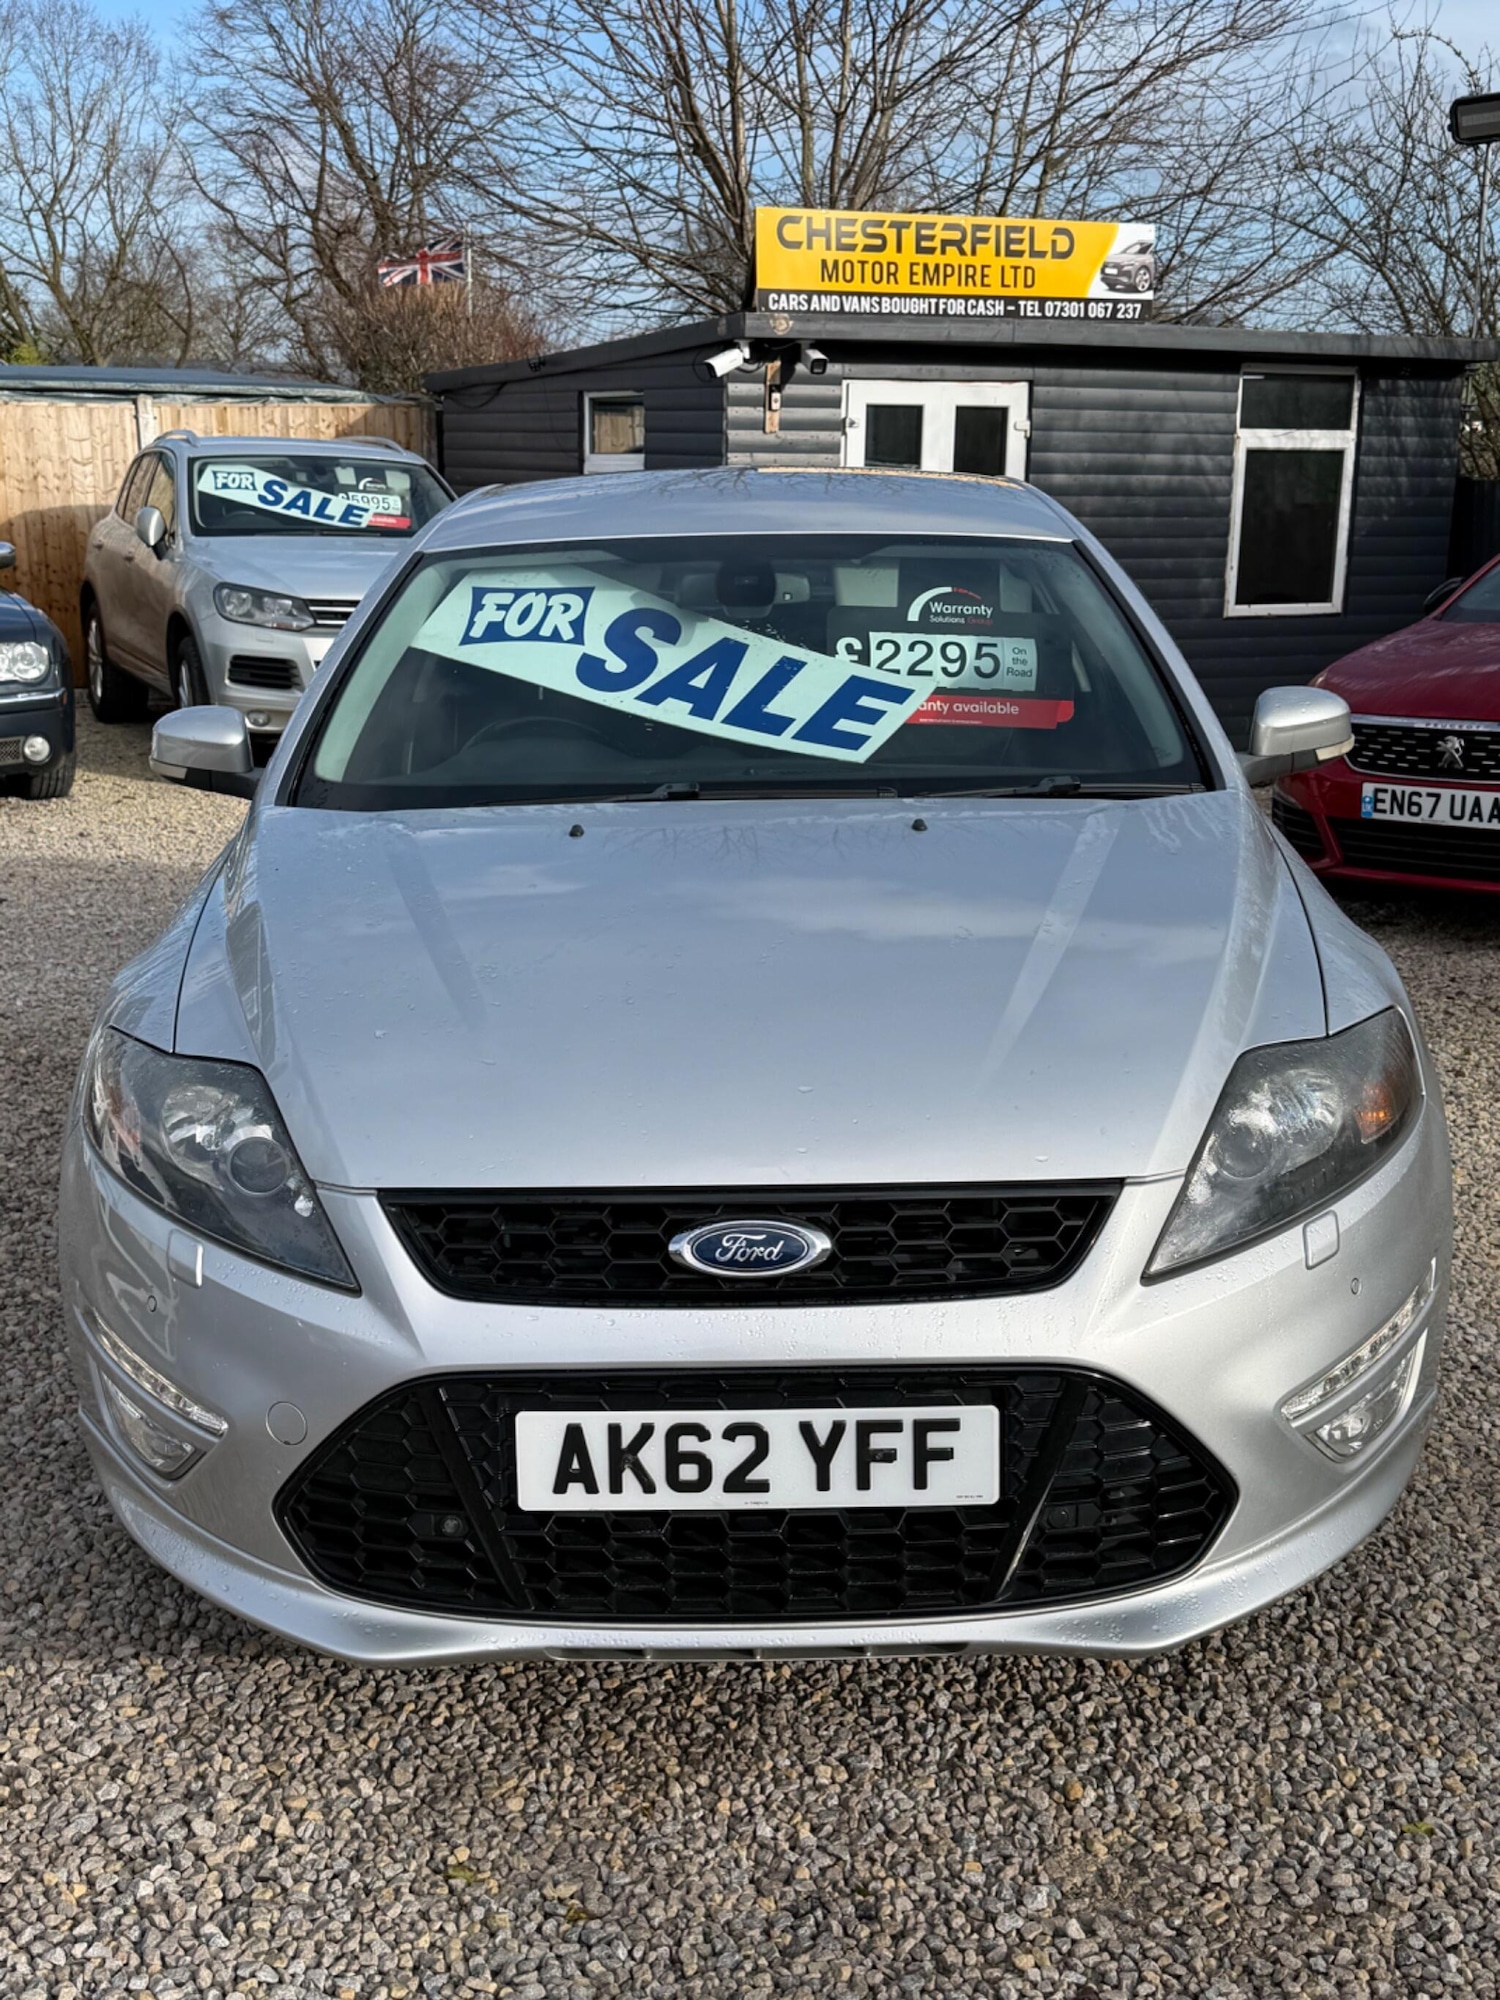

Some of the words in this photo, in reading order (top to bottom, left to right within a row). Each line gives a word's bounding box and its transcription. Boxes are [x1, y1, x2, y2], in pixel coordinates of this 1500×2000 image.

[776, 214, 1075, 259] CHESTERFIELD
[820, 259, 899, 286] MOTOR
[908, 261, 991, 288] EMPIRE
[1000, 264, 1036, 289] LTD
[768, 293, 808, 312] CARS
[810, 294, 841, 312] AND
[841, 296, 880, 313] VANS
[880, 296, 938, 315] BOUGHT
[939, 298, 967, 315] FOR
[967, 299, 1004, 317] CASH
[1018, 301, 1043, 318] TEL
[1044, 301, 1085, 319] 07301
[1087, 302, 1113, 319] 067
[1116, 303, 1142, 320] 237
[213, 471, 254, 490] FOR
[257, 479, 370, 526] SALE
[929, 601, 993, 619] Warranty
[929, 614, 965, 624] Solutions
[1012, 646, 1027, 655] On
[1012, 655, 1028, 666] the
[468, 590, 585, 643] FOR
[576, 607, 916, 752] SALE
[1006, 666, 1033, 678] Road
[953, 701, 1019, 715] available
[1373, 787, 1442, 819] EN67
[1449, 794, 1500, 823] UAA
[715, 1233, 785, 1262] Ford
[552, 1421, 771, 1495] AK62
[799, 1417, 961, 1492] YFF
